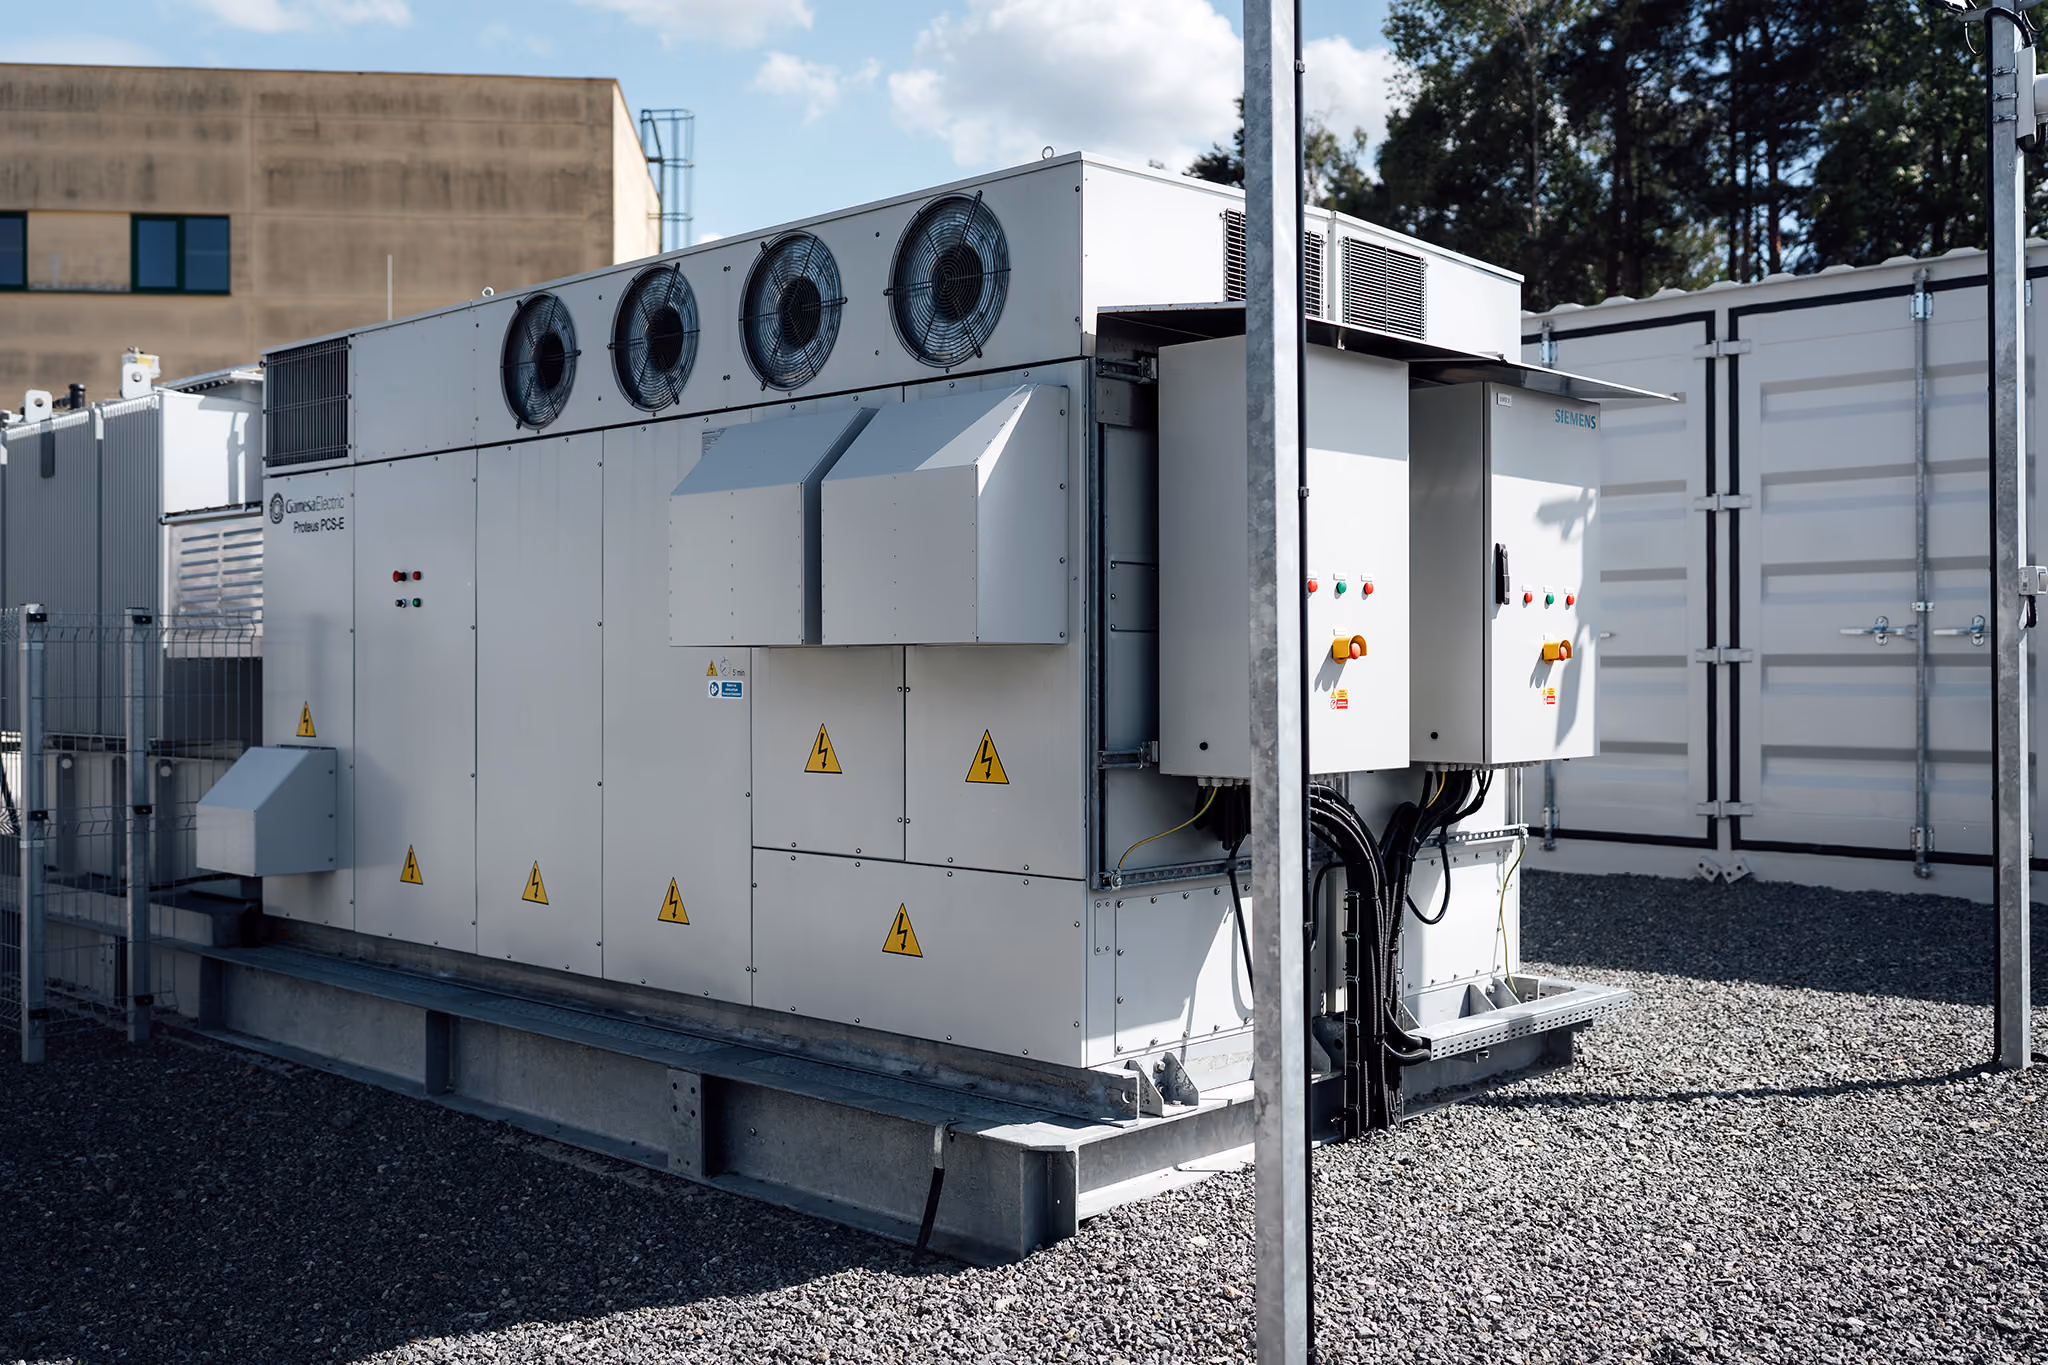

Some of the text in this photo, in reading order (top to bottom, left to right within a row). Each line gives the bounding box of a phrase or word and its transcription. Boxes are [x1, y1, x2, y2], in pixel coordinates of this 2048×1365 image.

[1555, 408, 1596, 430] SIEMENS
[294, 517, 344, 533] Proteus PCS-E
[732, 668, 745, 677] 5 min
